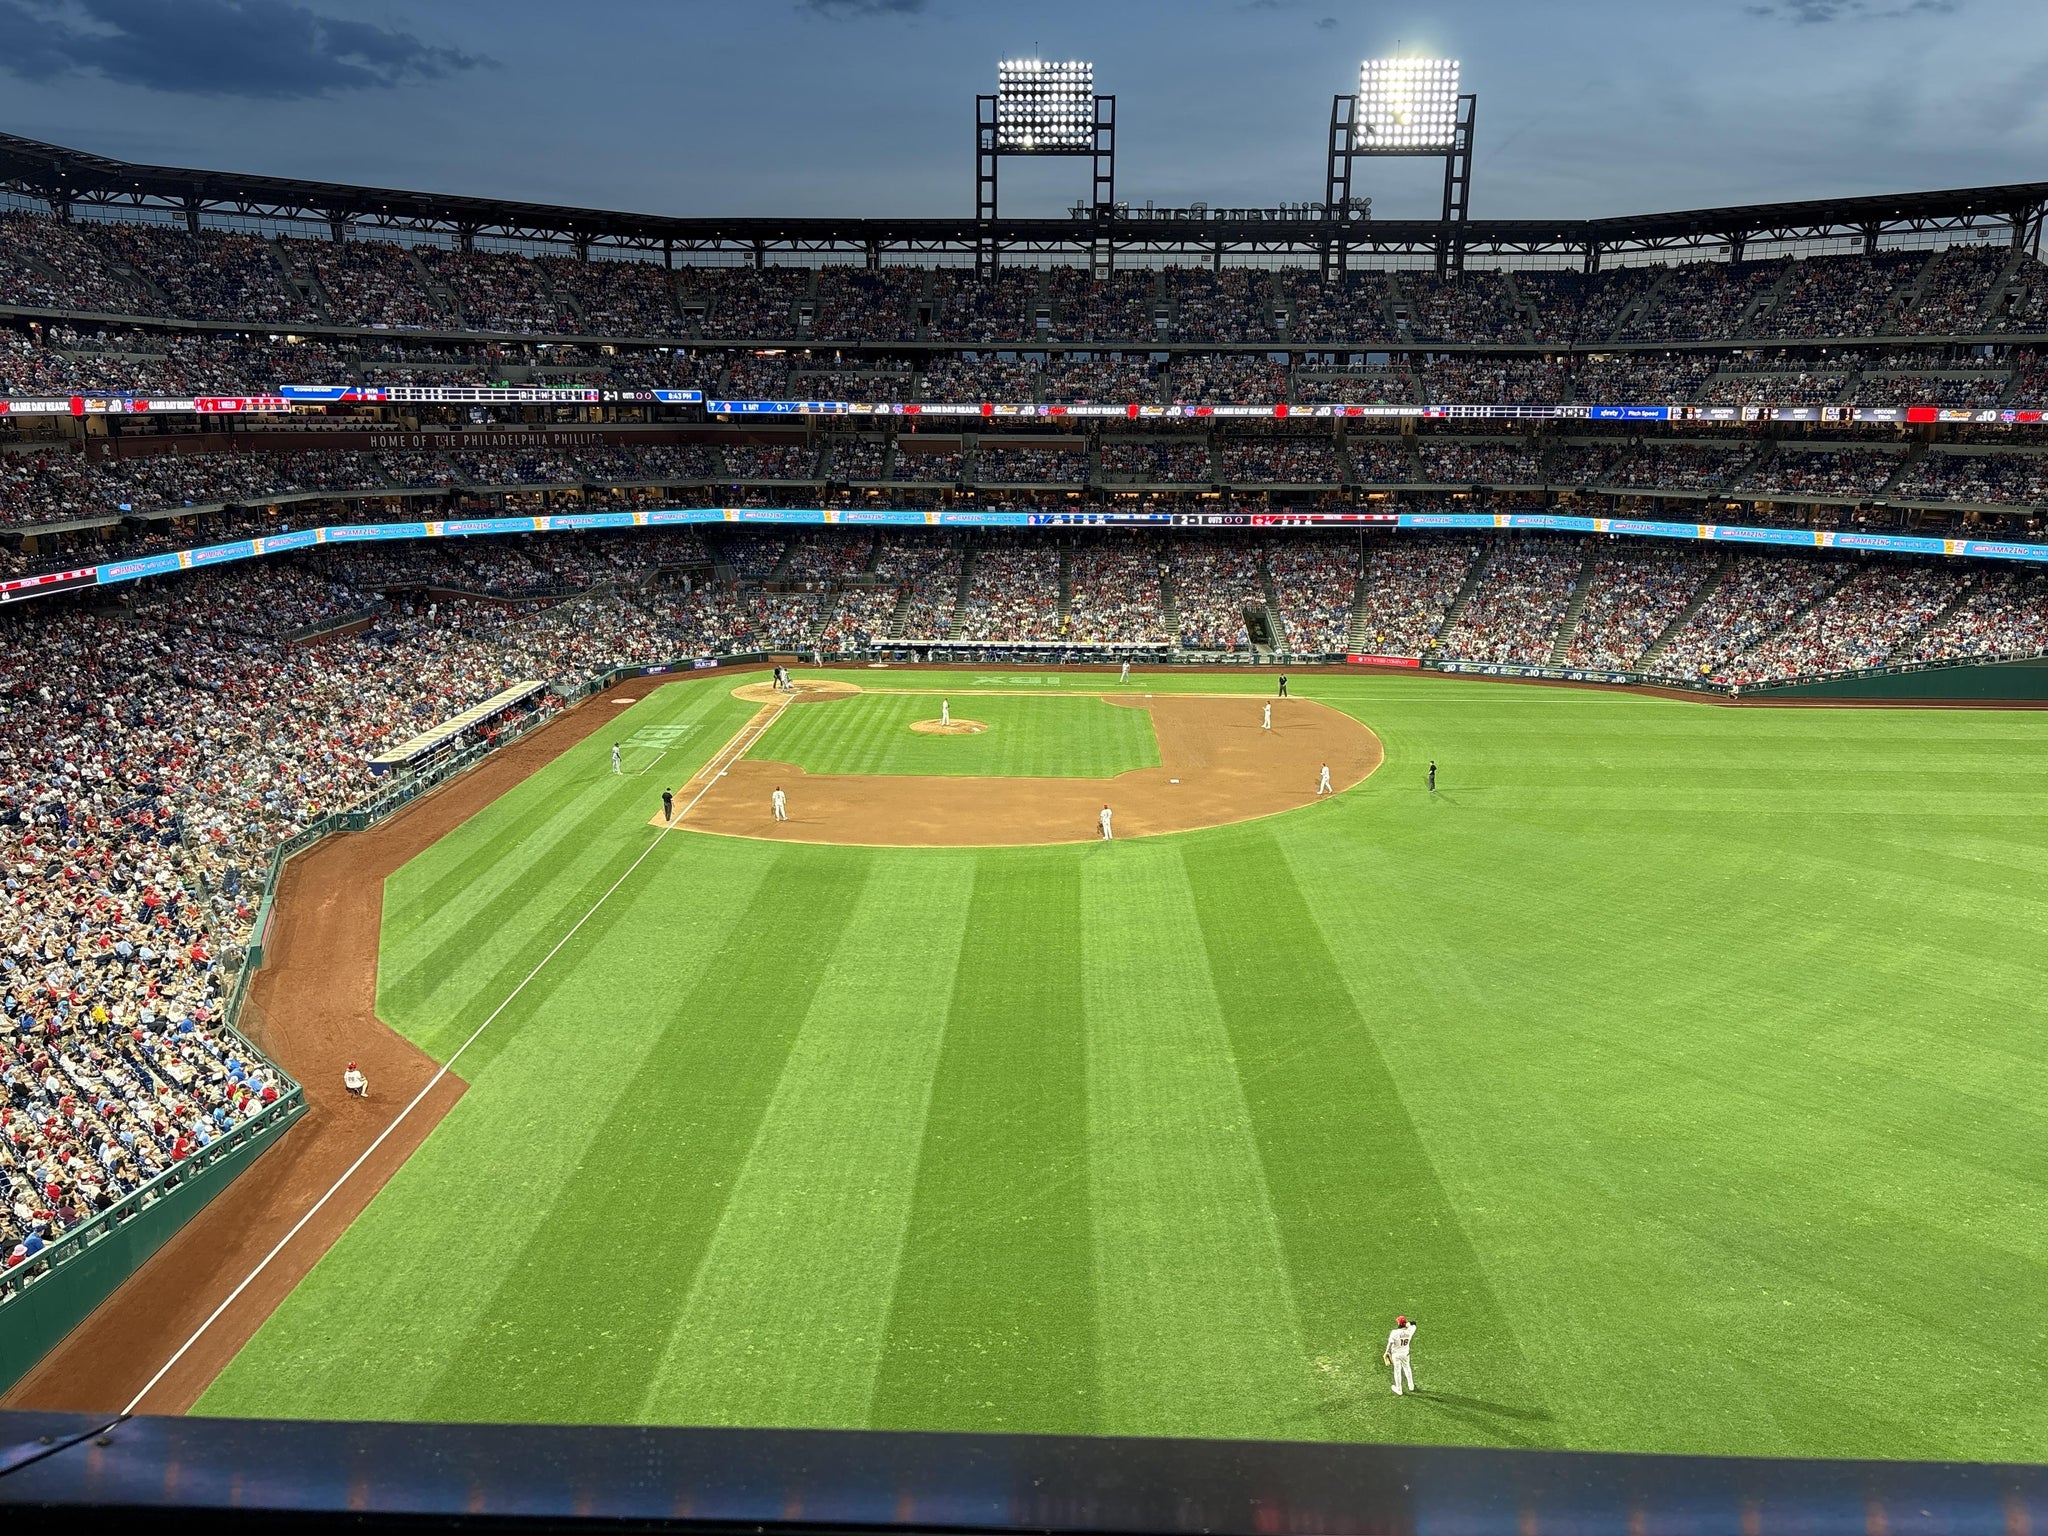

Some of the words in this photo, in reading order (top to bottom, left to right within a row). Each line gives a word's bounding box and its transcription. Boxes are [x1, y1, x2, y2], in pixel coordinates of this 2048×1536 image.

[604, 391, 618, 400] 2-1
[114, 400, 122, 411] 10
[880, 405, 889, 413] 10
[1026, 406, 1035, 414] 10
[1172, 407, 1181, 415] 10
[1322, 407, 1331, 416] 10
[1982, 410, 1996, 421] 10
[370, 436, 405, 448] HOME
[412, 435, 426, 446] OF
[434, 435, 456, 446] THE
[464, 434, 548, 446] PHILADELPHIA
[1992, 546, 2028, 554] AMAZING
[121, 564, 145, 573] AMAZING
[1530, 669, 1540, 677] 10
[1573, 672, 1582, 680] 10
